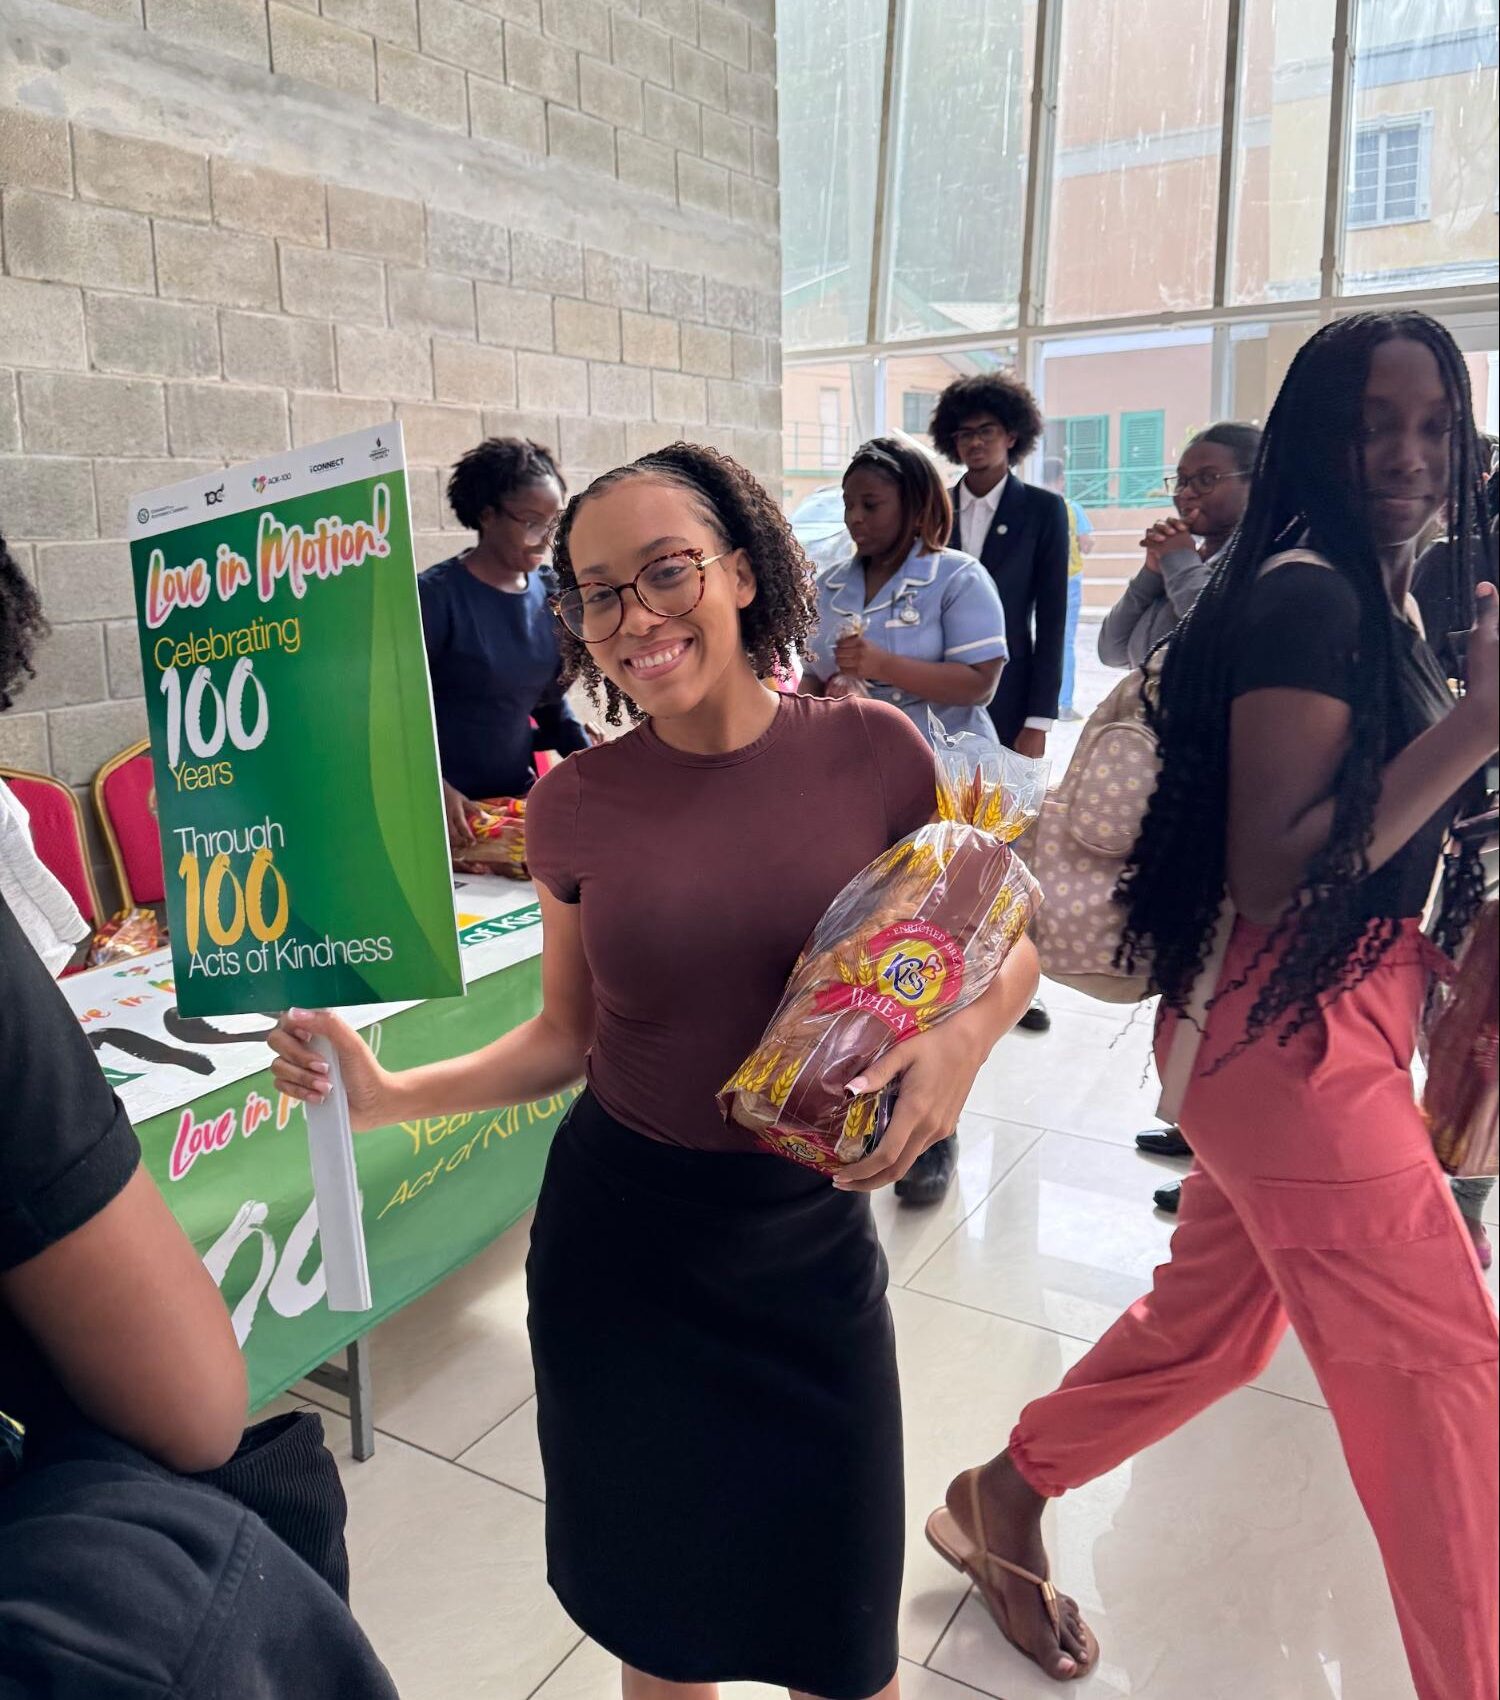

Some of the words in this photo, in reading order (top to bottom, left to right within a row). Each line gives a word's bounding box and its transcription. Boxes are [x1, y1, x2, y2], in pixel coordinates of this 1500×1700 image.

[146, 548, 211, 629] Love
[216, 543, 251, 601] in
[257, 483, 391, 602] Motion!
[154, 616, 300, 671] Celebrating
[160, 656, 269, 768] 100
[168, 761, 234, 792] Years
[173, 816, 284, 858] Through
[178, 847, 289, 956] 100
[189, 948, 241, 978] Acts
[246, 941, 269, 972] of
[275, 934, 394, 971] Kindness
[850, 987, 914, 1031] WHEA
[170, 1108, 236, 1181] Love
[242, 1091, 271, 1138] in
